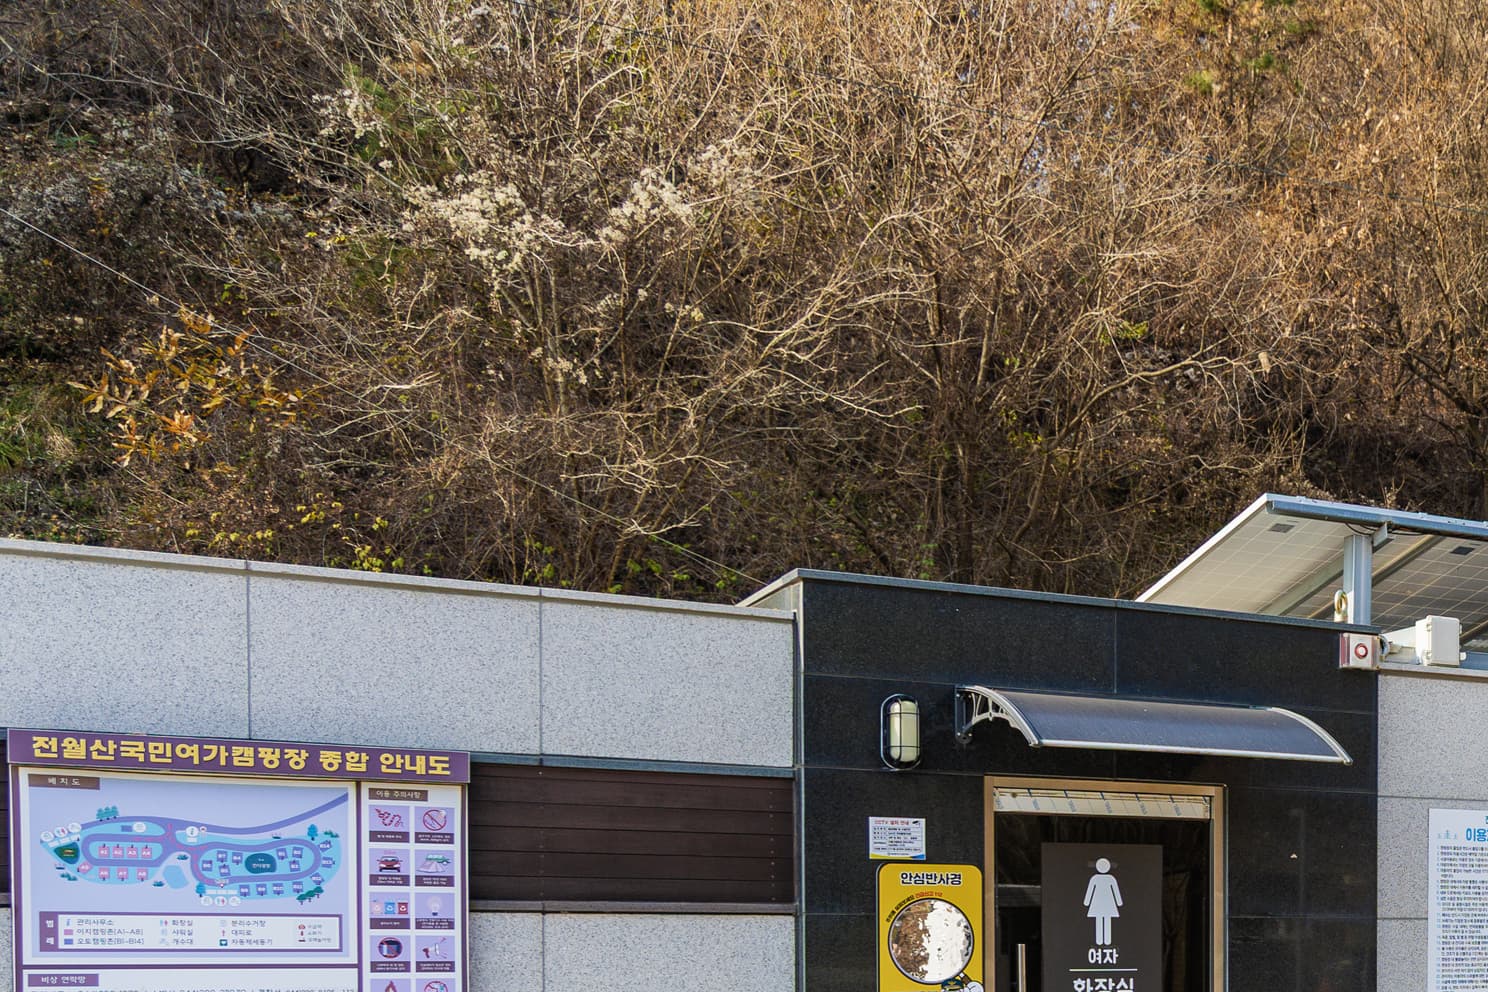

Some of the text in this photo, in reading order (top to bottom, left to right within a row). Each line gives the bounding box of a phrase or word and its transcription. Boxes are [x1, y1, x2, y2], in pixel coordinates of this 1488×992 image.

[32, 736, 451, 775] 전월산국민여가캠핑장 종합 안내도
[900, 872, 962, 886] 안심반사경
[1088, 949, 1119, 965] 여자
[41, 976, 86, 984] 비상 연락망
